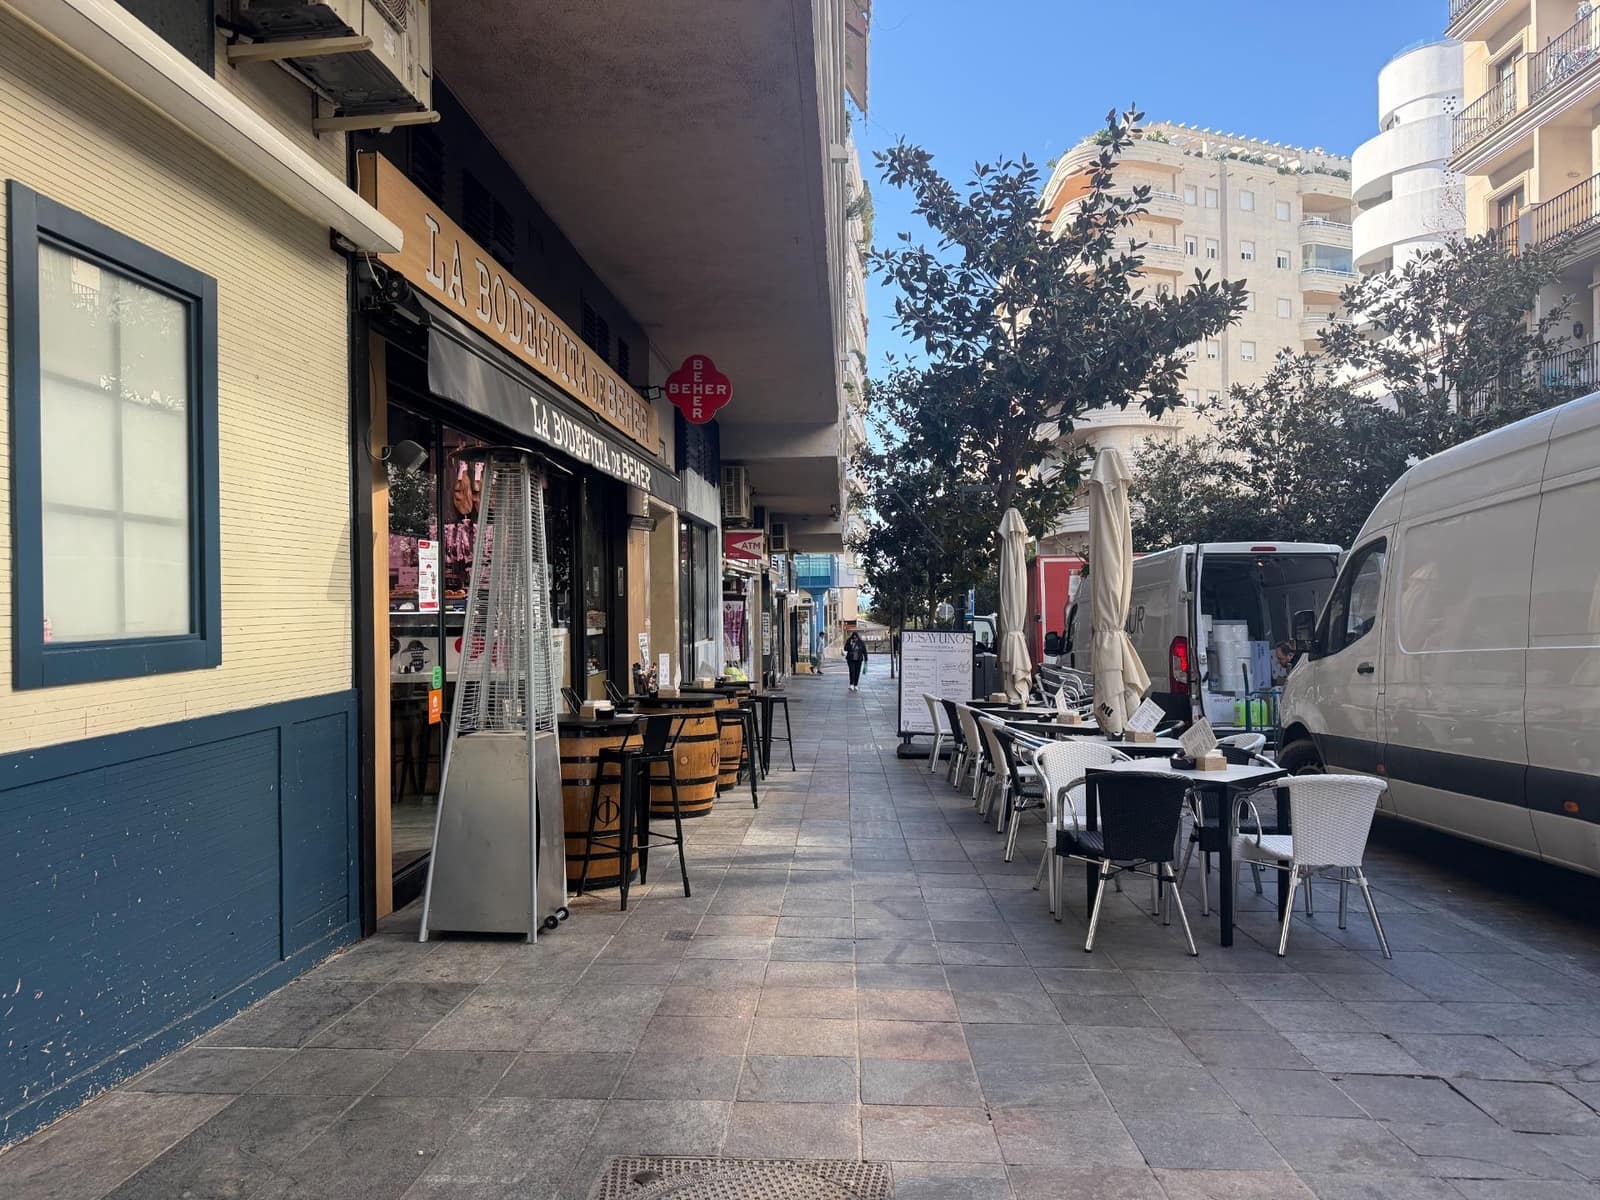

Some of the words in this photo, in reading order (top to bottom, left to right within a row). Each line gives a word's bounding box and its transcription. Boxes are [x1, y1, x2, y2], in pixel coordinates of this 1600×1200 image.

[425, 213, 467, 307] LA
[475, 257, 589, 397] BODEGUITA
[592, 367, 606, 412] DE
[608, 374, 649, 443] BEHER
[669, 383, 727, 396] BEHER
[530, 396, 551, 440] LA
[552, 410, 611, 470] BODEGUITA
[621, 452, 651, 491] BEHER
[742, 541, 761, 550] ATM
